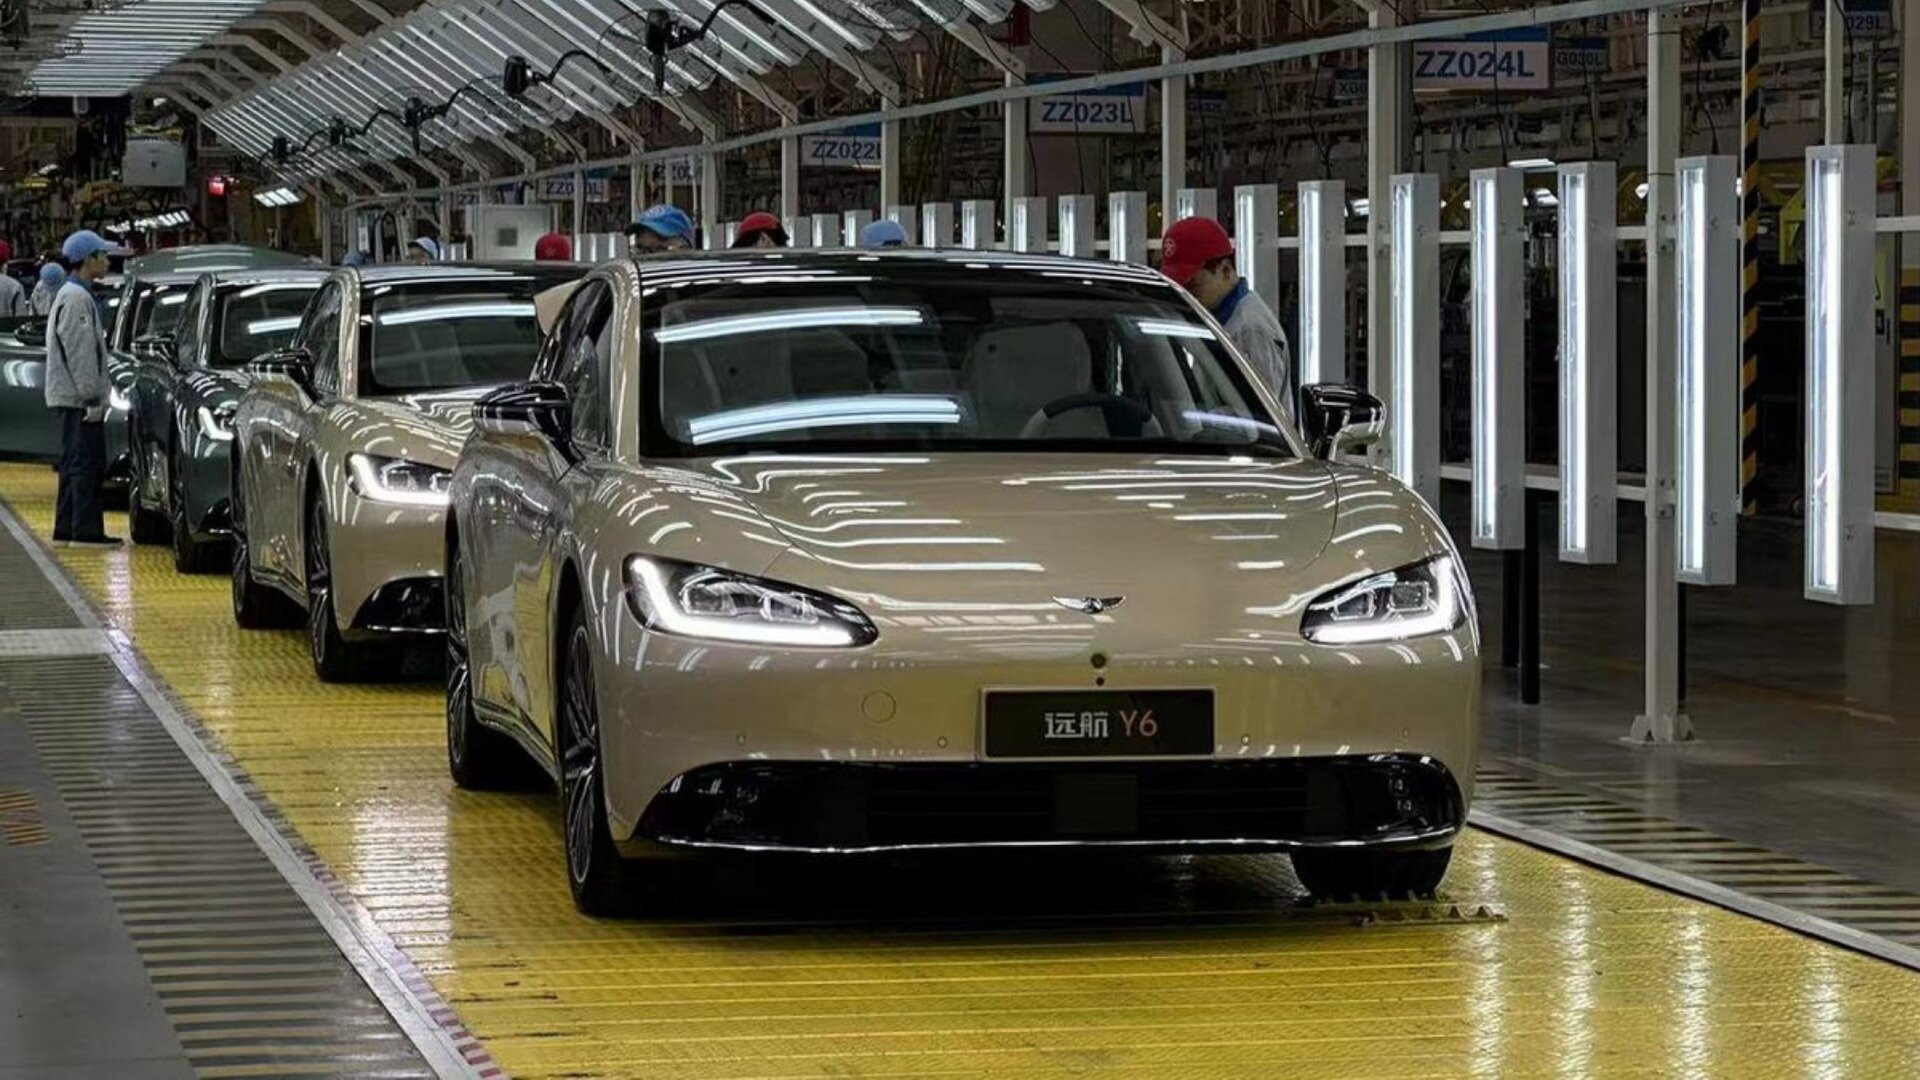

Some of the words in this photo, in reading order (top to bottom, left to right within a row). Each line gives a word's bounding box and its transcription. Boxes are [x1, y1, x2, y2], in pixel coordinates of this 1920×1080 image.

[1818, 15, 1884, 30] X029L
[1416, 50, 1534, 77] ZZ024L
[1042, 101, 1133, 123] ZZ023L
[546, 181, 601, 195] ZZ0L
[1043, 711, 1109, 739] 远航
[1119, 710, 1159, 737] Y6
